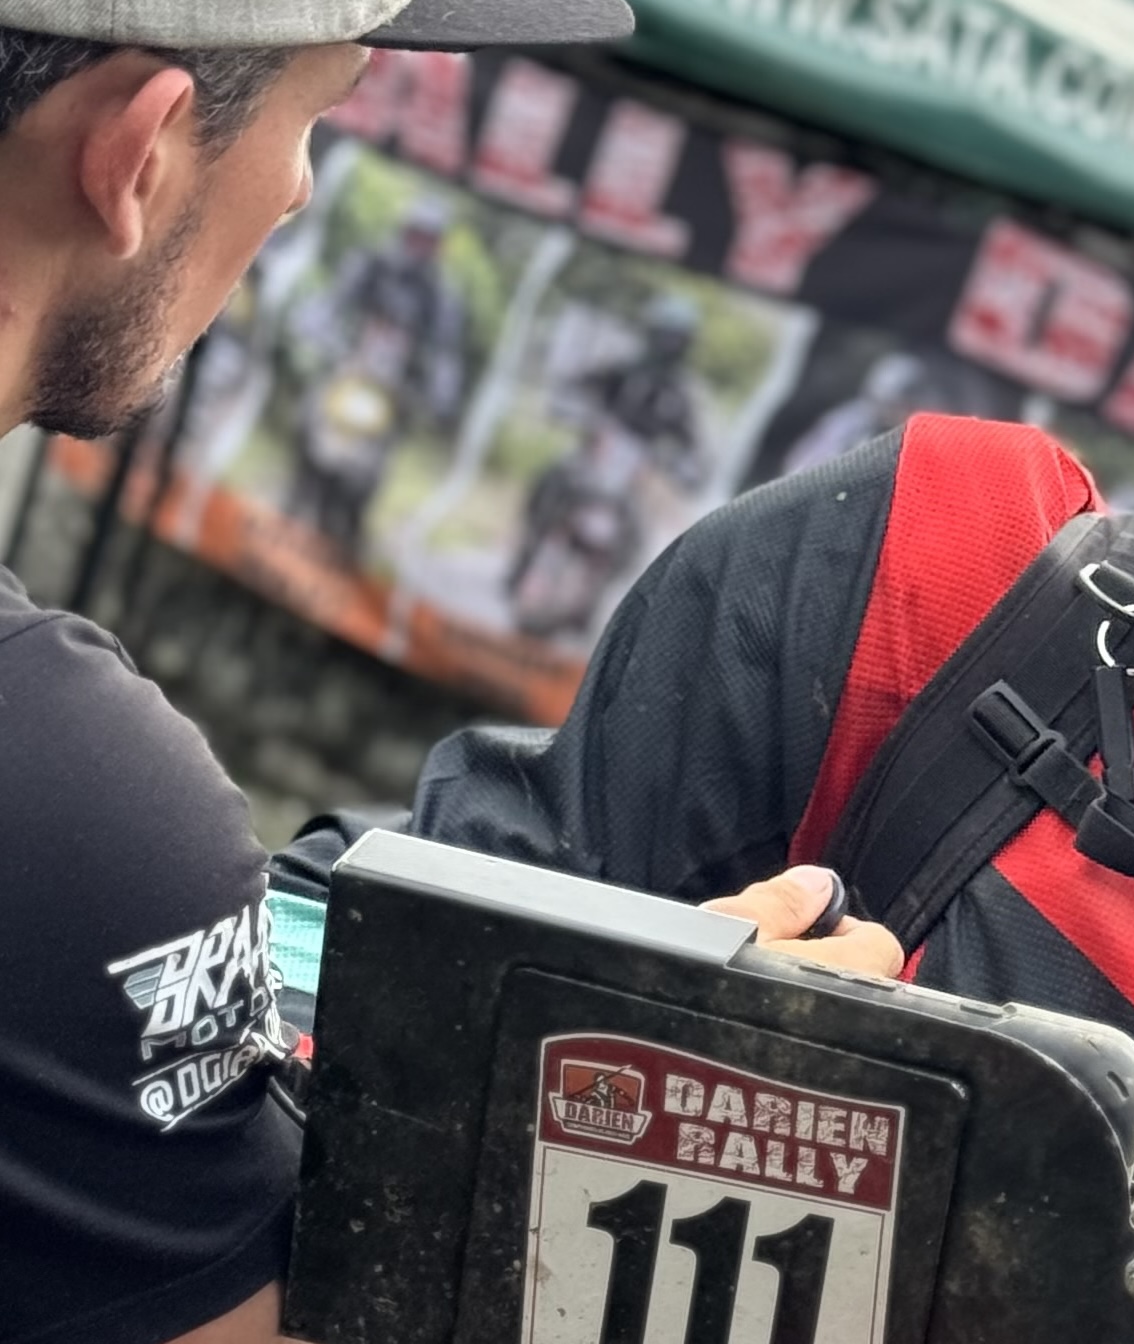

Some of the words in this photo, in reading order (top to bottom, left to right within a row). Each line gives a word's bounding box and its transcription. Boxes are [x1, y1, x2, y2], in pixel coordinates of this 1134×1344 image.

[322, 48, 880, 296] ALLY
[564, 1101, 635, 1133] DARIEN
[664, 1073, 890, 1156] DARIEN
[676, 1122, 869, 1195] RALLY
